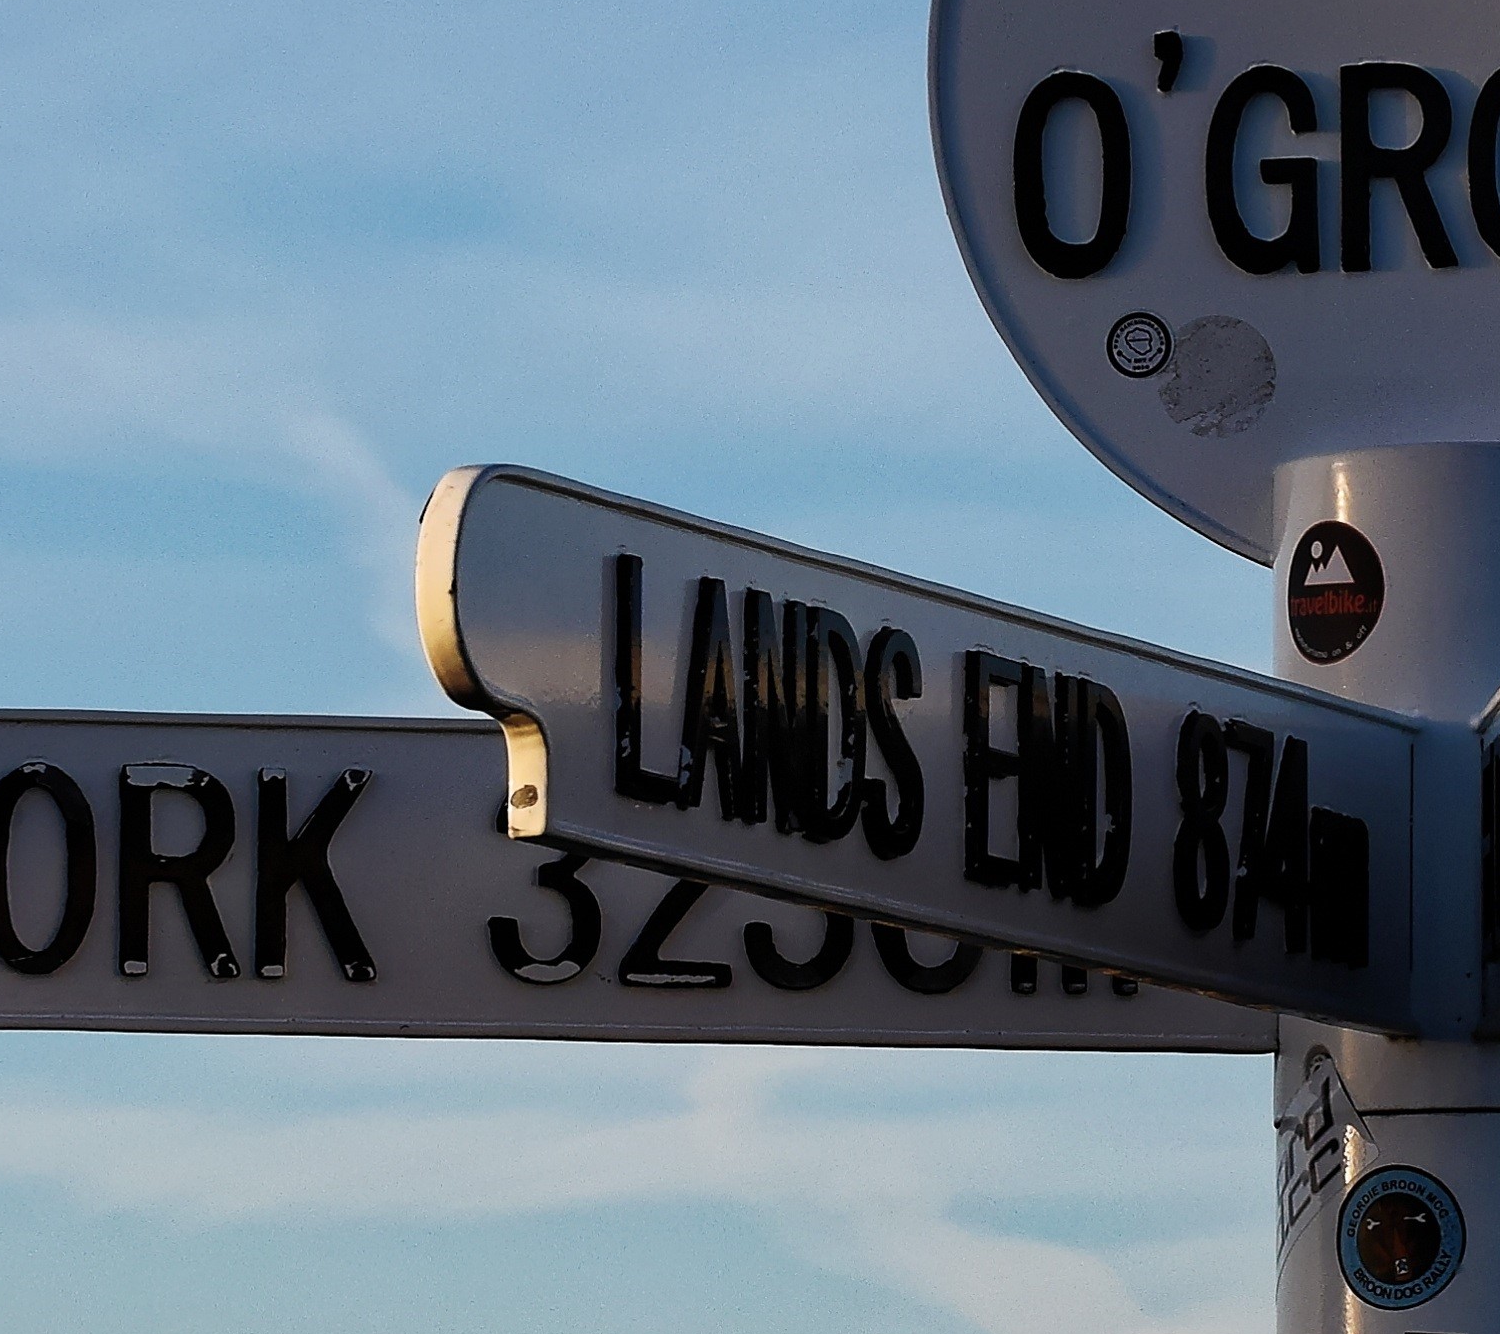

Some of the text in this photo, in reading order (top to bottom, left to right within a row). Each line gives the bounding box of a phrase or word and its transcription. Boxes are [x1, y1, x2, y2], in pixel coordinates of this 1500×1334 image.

[613, 553, 925, 860] LANDS
[963, 650, 1133, 907] END
[1174, 709, 1370, 969] 874m
[1347, 1185, 1381, 1238] GEORDIE
[1381, 1180, 1426, 1196] BROON
[1353, 1248, 1452, 1300] BROON DOG RALLY
